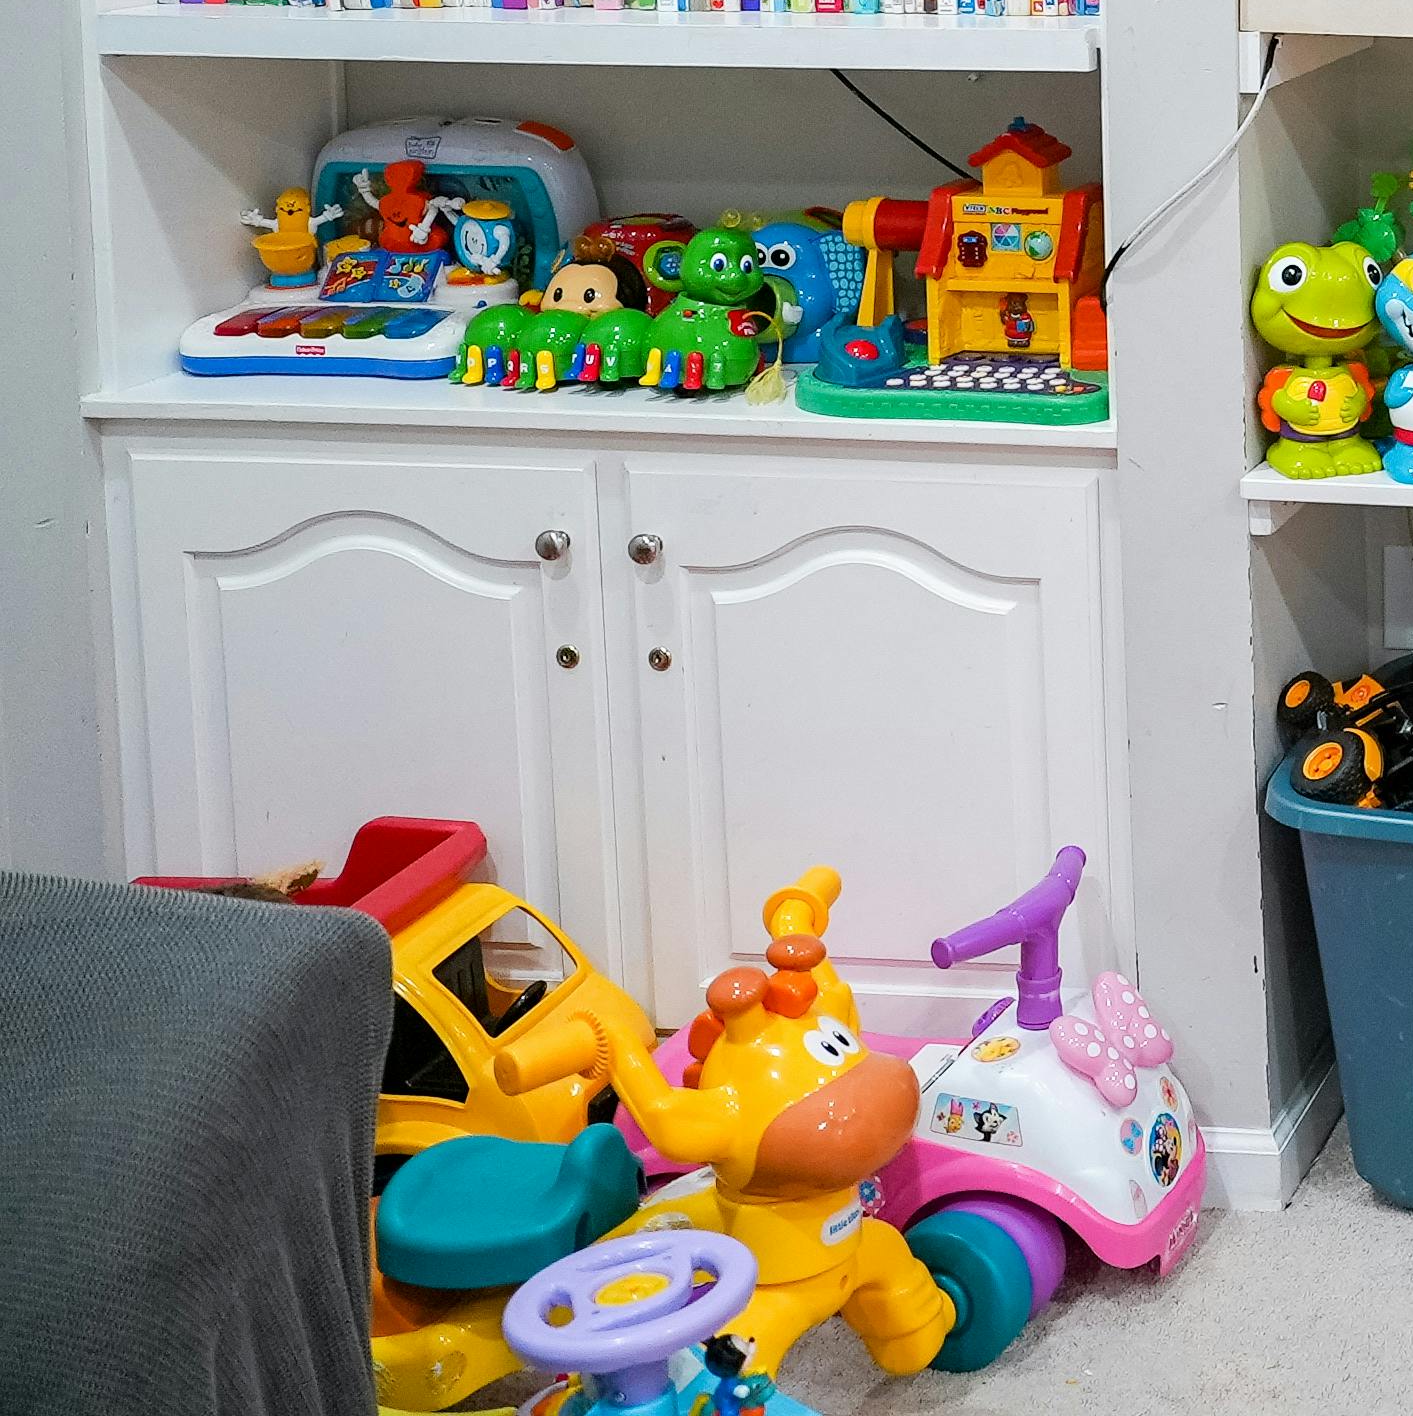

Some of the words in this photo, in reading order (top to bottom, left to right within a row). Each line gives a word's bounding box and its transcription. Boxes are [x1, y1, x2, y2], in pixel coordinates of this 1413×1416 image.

[487, 358, 497, 368] P
[586, 355, 595, 365] U
[606, 357, 616, 367] V
